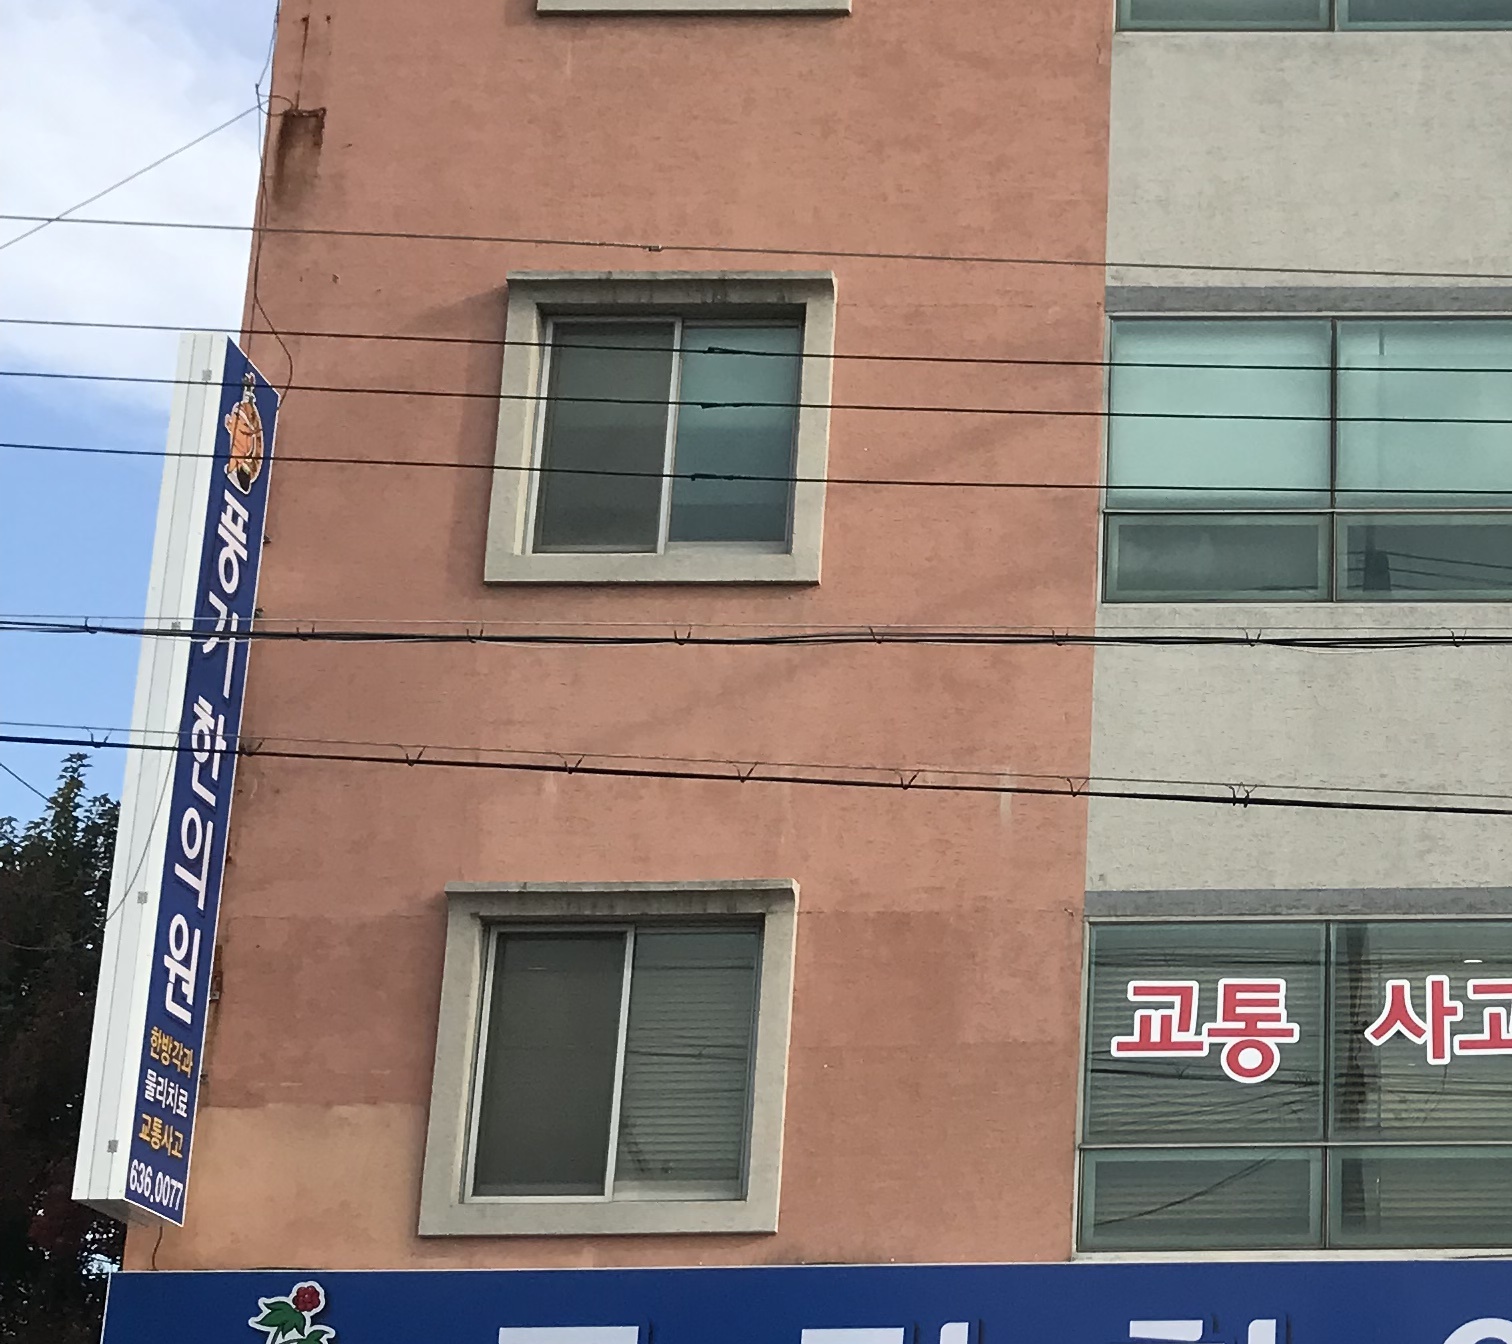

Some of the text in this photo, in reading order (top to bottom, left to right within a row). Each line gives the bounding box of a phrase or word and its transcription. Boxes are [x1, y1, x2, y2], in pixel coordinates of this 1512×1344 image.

[150, 1025, 194, 1079] 한방각과
[1111, 977, 1301, 1084] 교통
[144, 1068, 189, 1119] 물리치료
[138, 1112, 184, 1159] 교통사고
[129, 1158, 184, 1211] 636.0077
